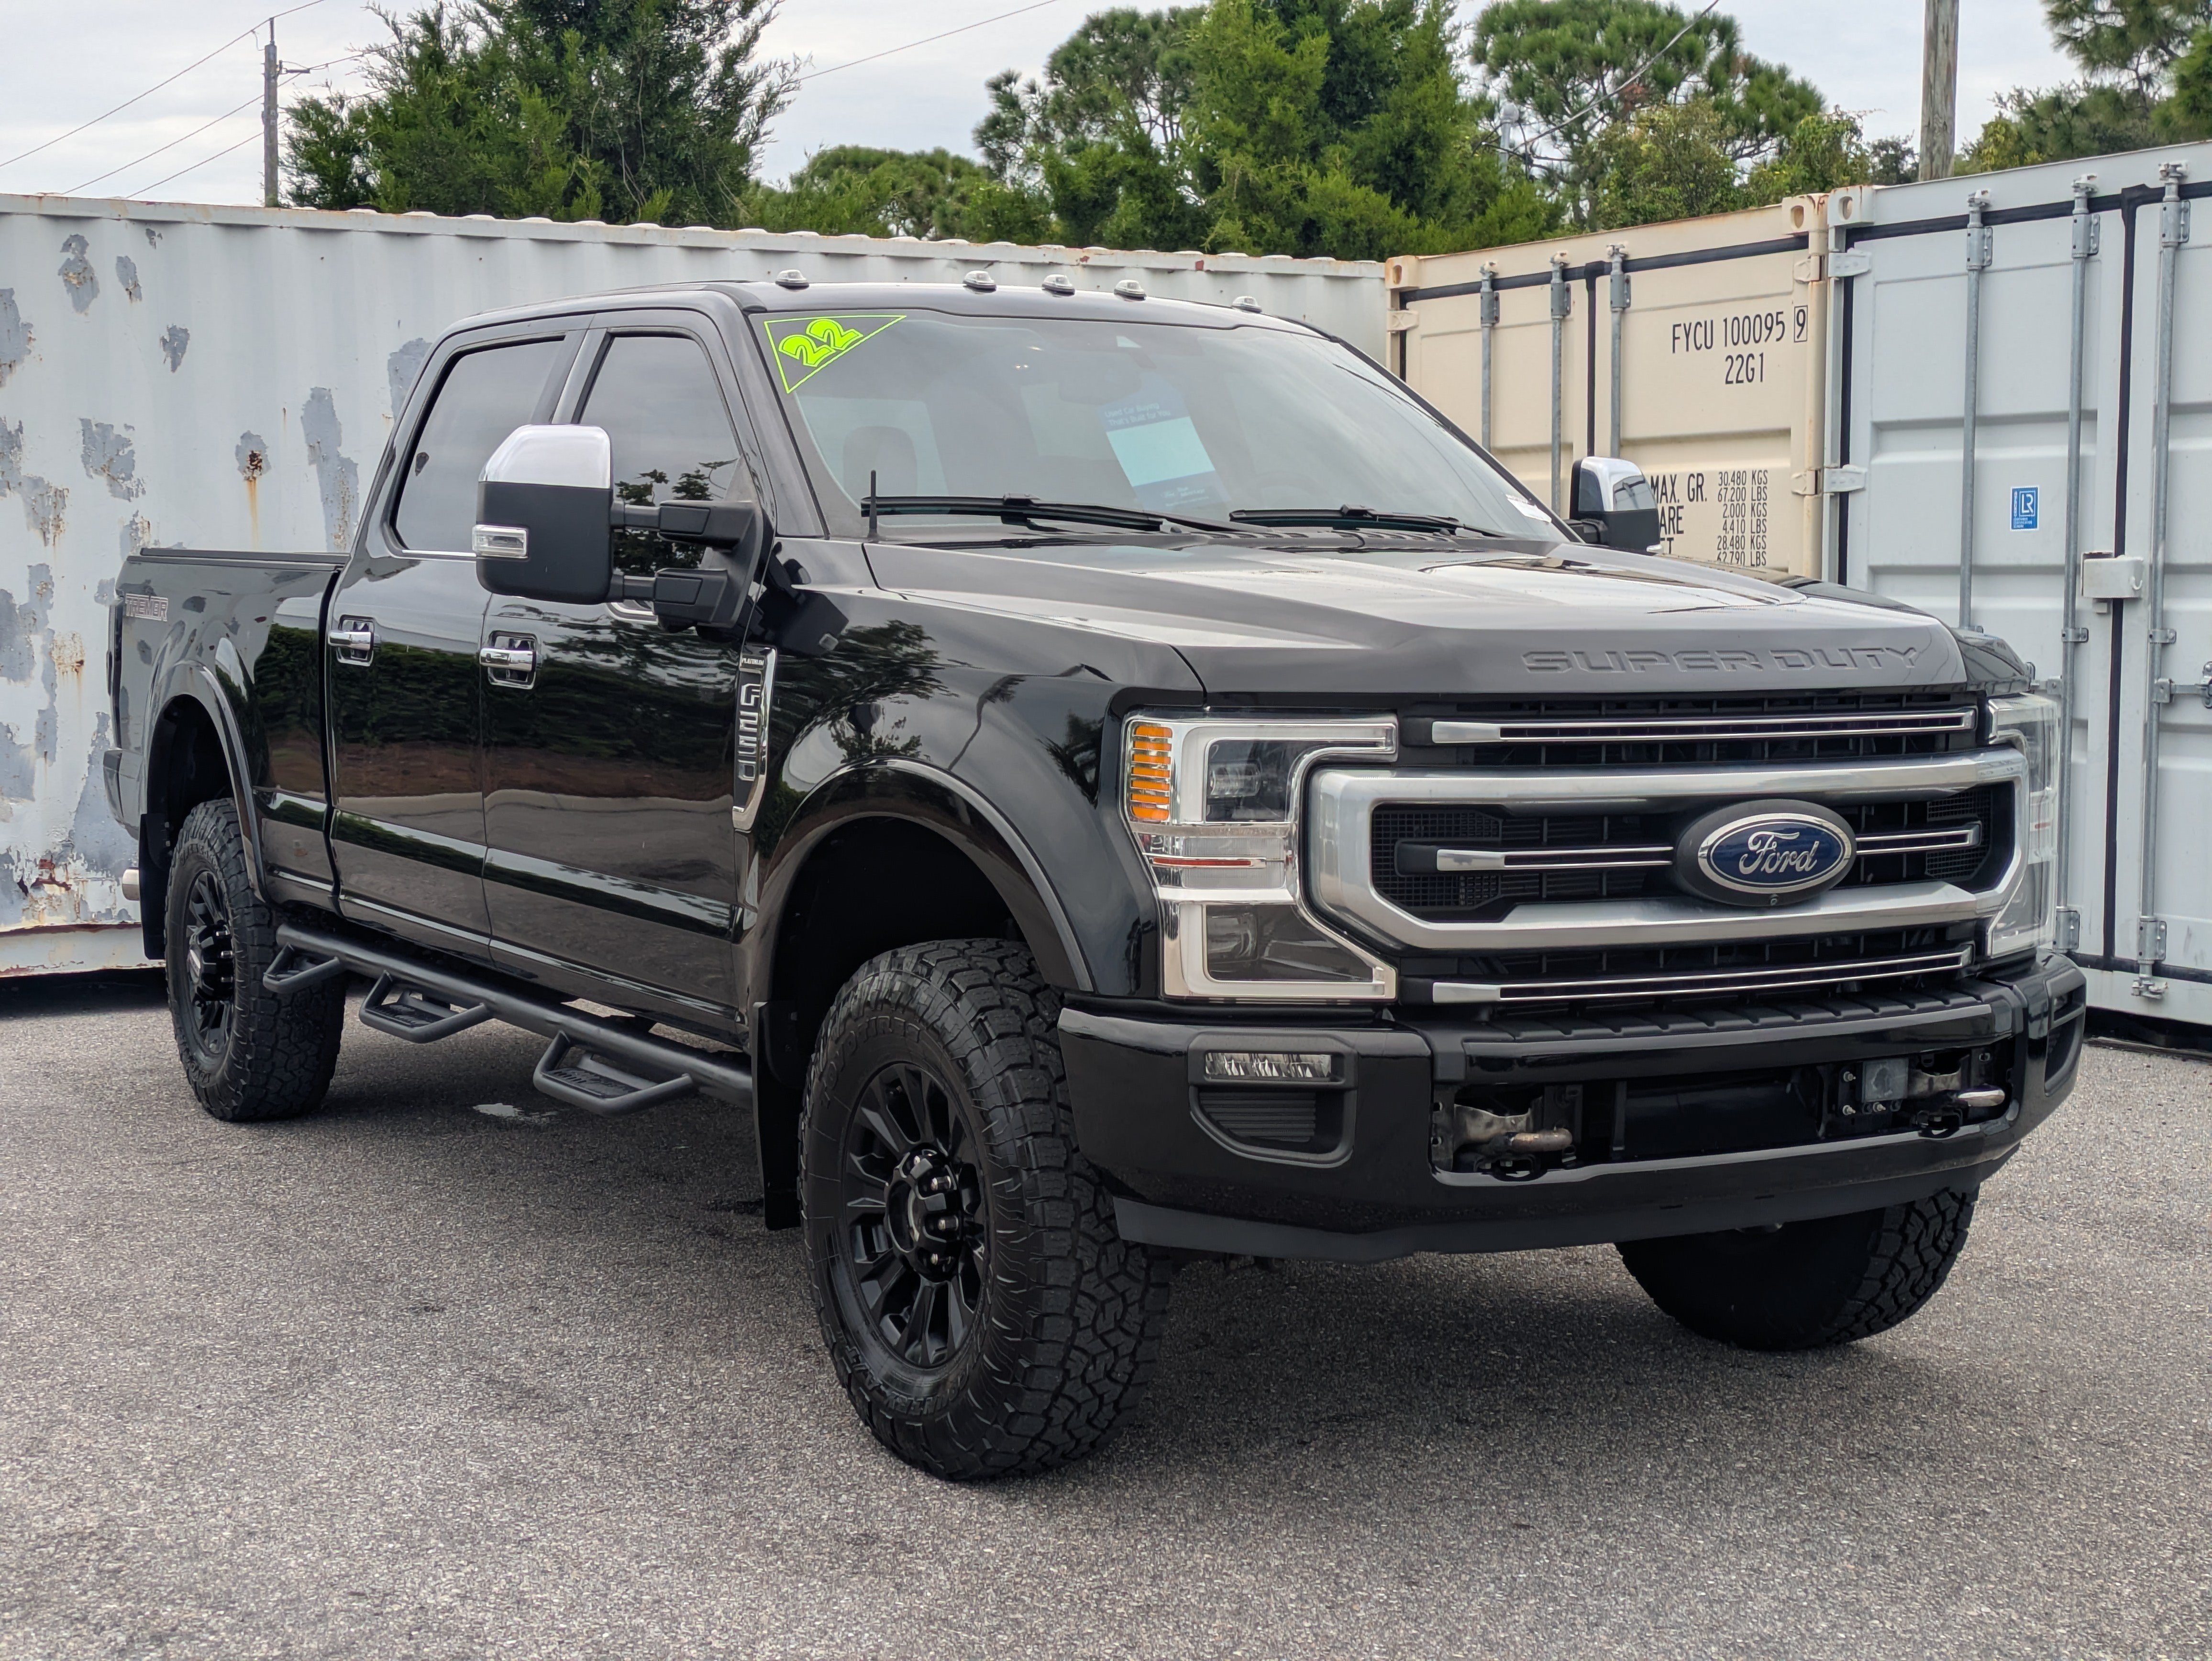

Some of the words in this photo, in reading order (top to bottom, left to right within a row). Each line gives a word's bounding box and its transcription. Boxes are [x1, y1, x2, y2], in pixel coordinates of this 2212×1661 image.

[778, 318, 863, 367] 22
[1672, 320, 1714, 354] FYCU
[1723, 311, 1785, 347] 100095
[1796, 309, 1806, 339] 9
[1725, 352, 1764, 384] 22G1
[1136, 402, 1160, 412] Buying
[1650, 474, 1680, 503] MAX.
[1687, 472, 1707, 502] GR.
[1718, 470, 1747, 486] 30.480
[1751, 469, 1769, 485] KGS
[1717, 487, 1746, 502] 67.200
[1751, 486, 1768, 502] LBS
[2022, 493, 2034, 513] LR
[1660, 505, 1684, 535] ARE
[1723, 503, 1746, 518] 2.000
[1750, 502, 1768, 518] KGS
[1723, 519, 1746, 534] 4.410
[1750, 518, 1767, 534] LBS
[1717, 535, 1746, 551] 28.480
[1750, 534, 1767, 550] KGS
[1717, 551, 1746, 566] 62790
[1750, 551, 1767, 566] LBS
[125, 593, 169, 622] TREMOR
[1522, 649, 1763, 673] SUPER
[1768, 646, 1919, 671] DUTY
[737, 683, 761, 781] F250
[1738, 831, 1820, 875] Ford
